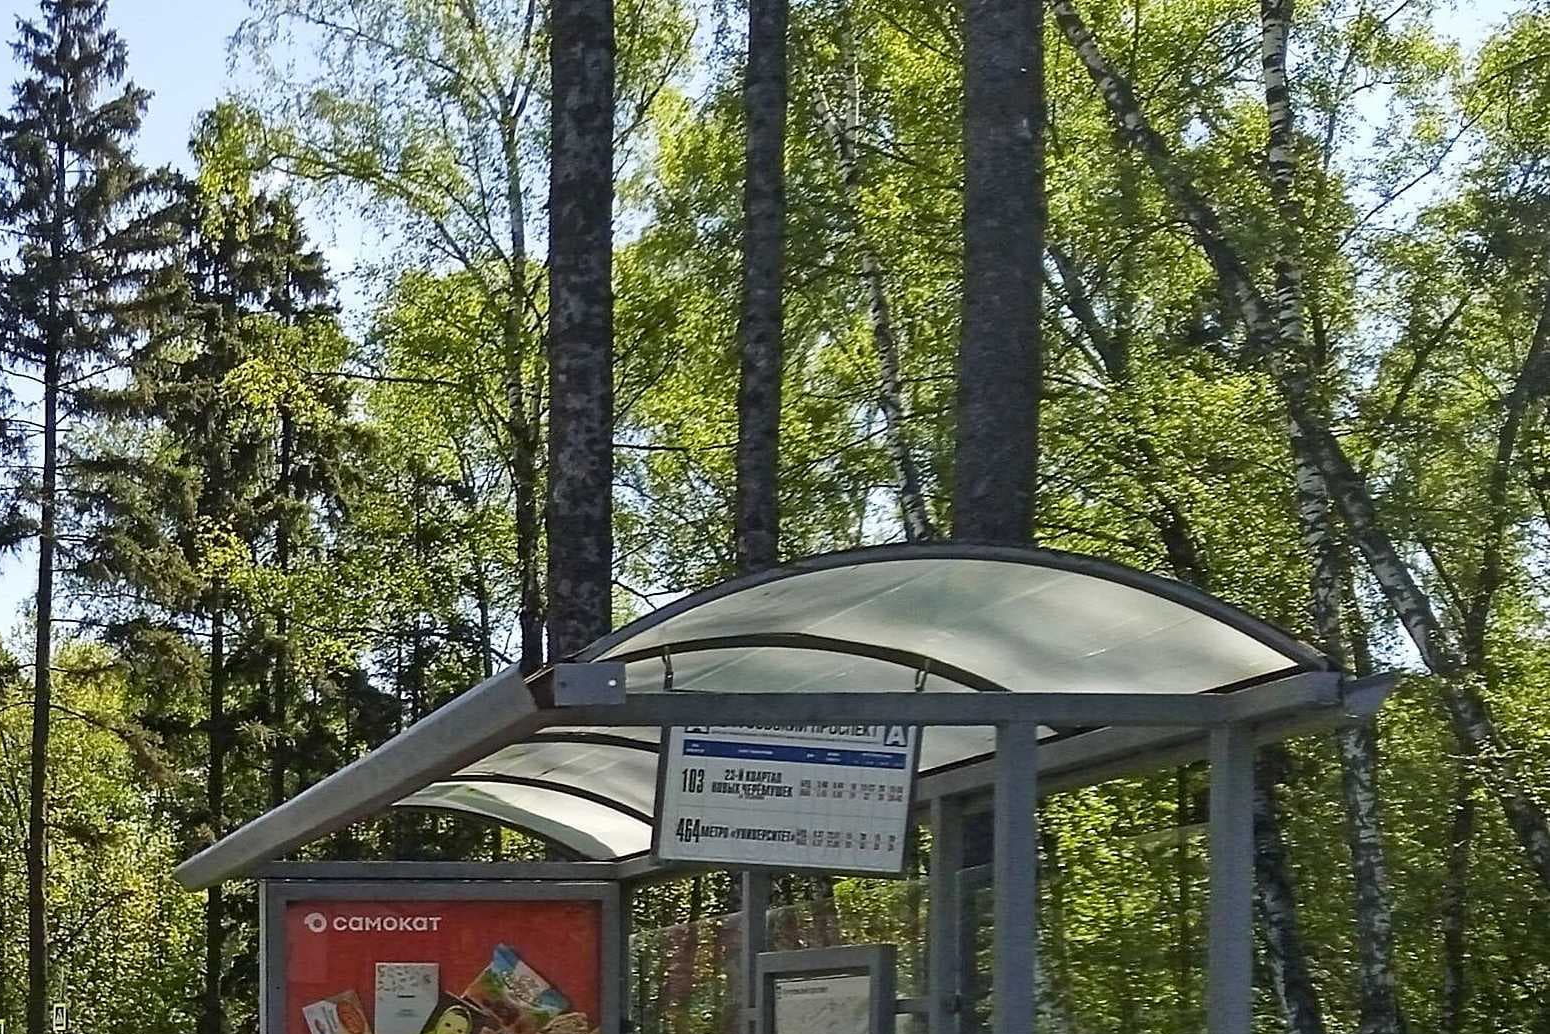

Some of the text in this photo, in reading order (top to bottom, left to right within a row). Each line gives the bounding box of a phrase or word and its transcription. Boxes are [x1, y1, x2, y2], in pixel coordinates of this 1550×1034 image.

[681, 768, 705, 793] 103
[745, 770, 783, 784] КВАРТАЛ
[711, 781, 740, 794] НОВЫХ
[676, 817, 700, 843] 464
[700, 825, 729, 838] МЕТРО
[332, 916, 443, 931] самокат
